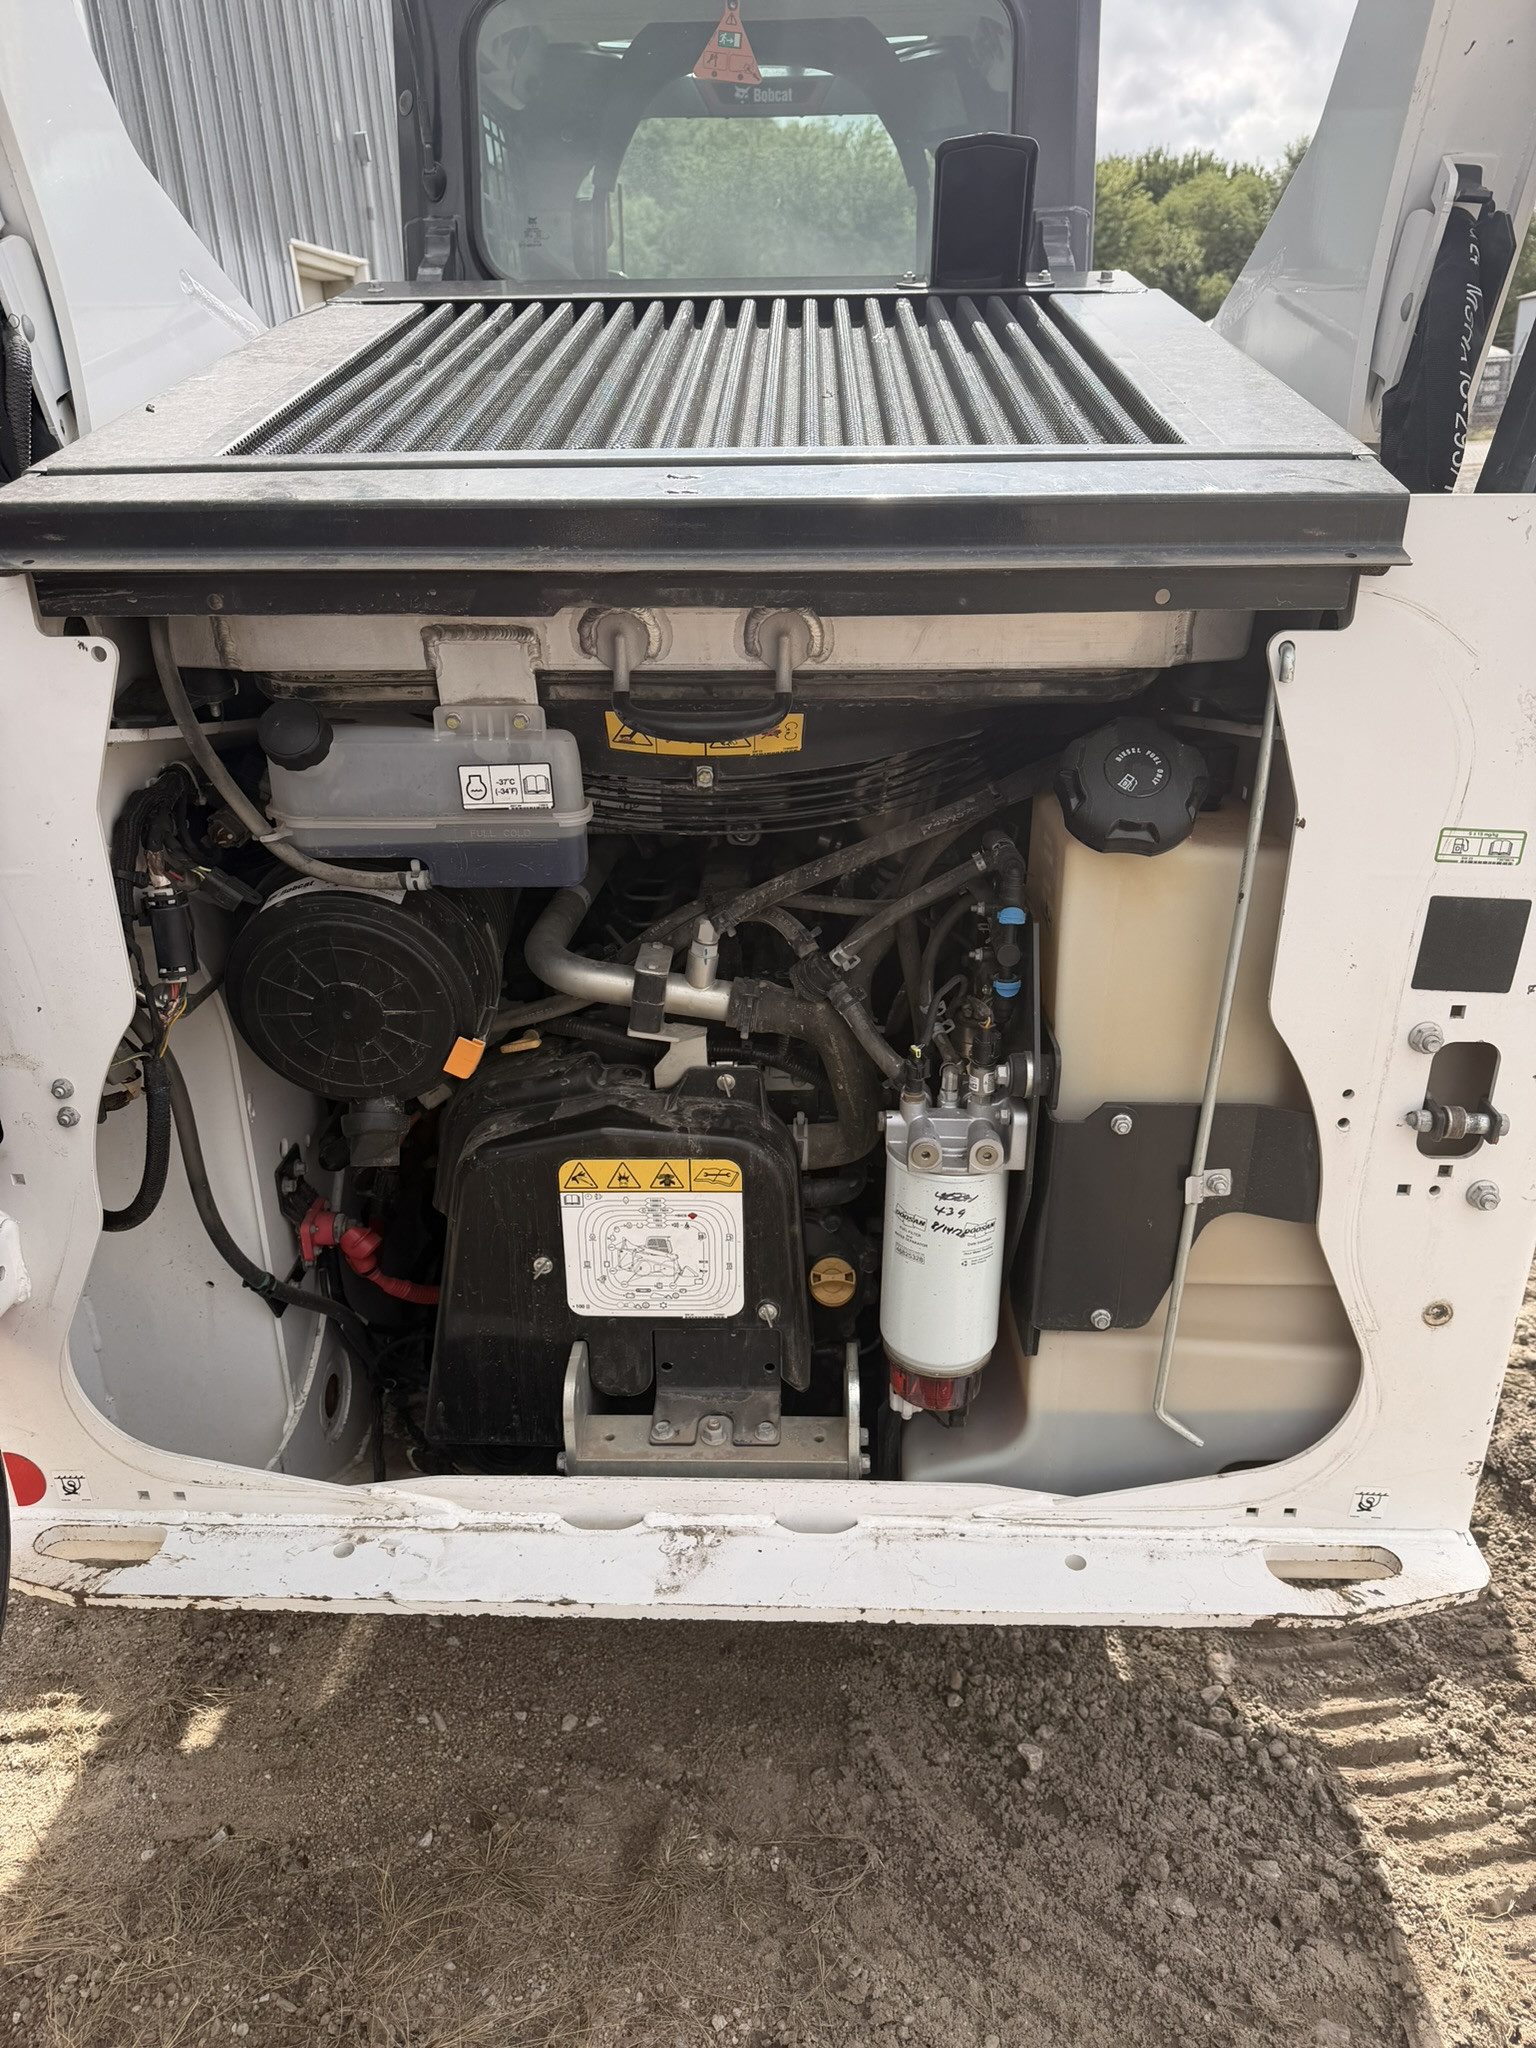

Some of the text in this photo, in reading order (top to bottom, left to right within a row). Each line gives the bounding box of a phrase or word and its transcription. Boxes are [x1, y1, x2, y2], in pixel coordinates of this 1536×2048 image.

[753, 87, 793, 103] Bobcat
[1115, 747, 1164, 785] DIESEL FUEL ONLY
[470, 829, 531, 838] FULL COLD
[895, 1208, 926, 1226] DOOSAN
[964, 1221, 996, 1235] DOOSAN
